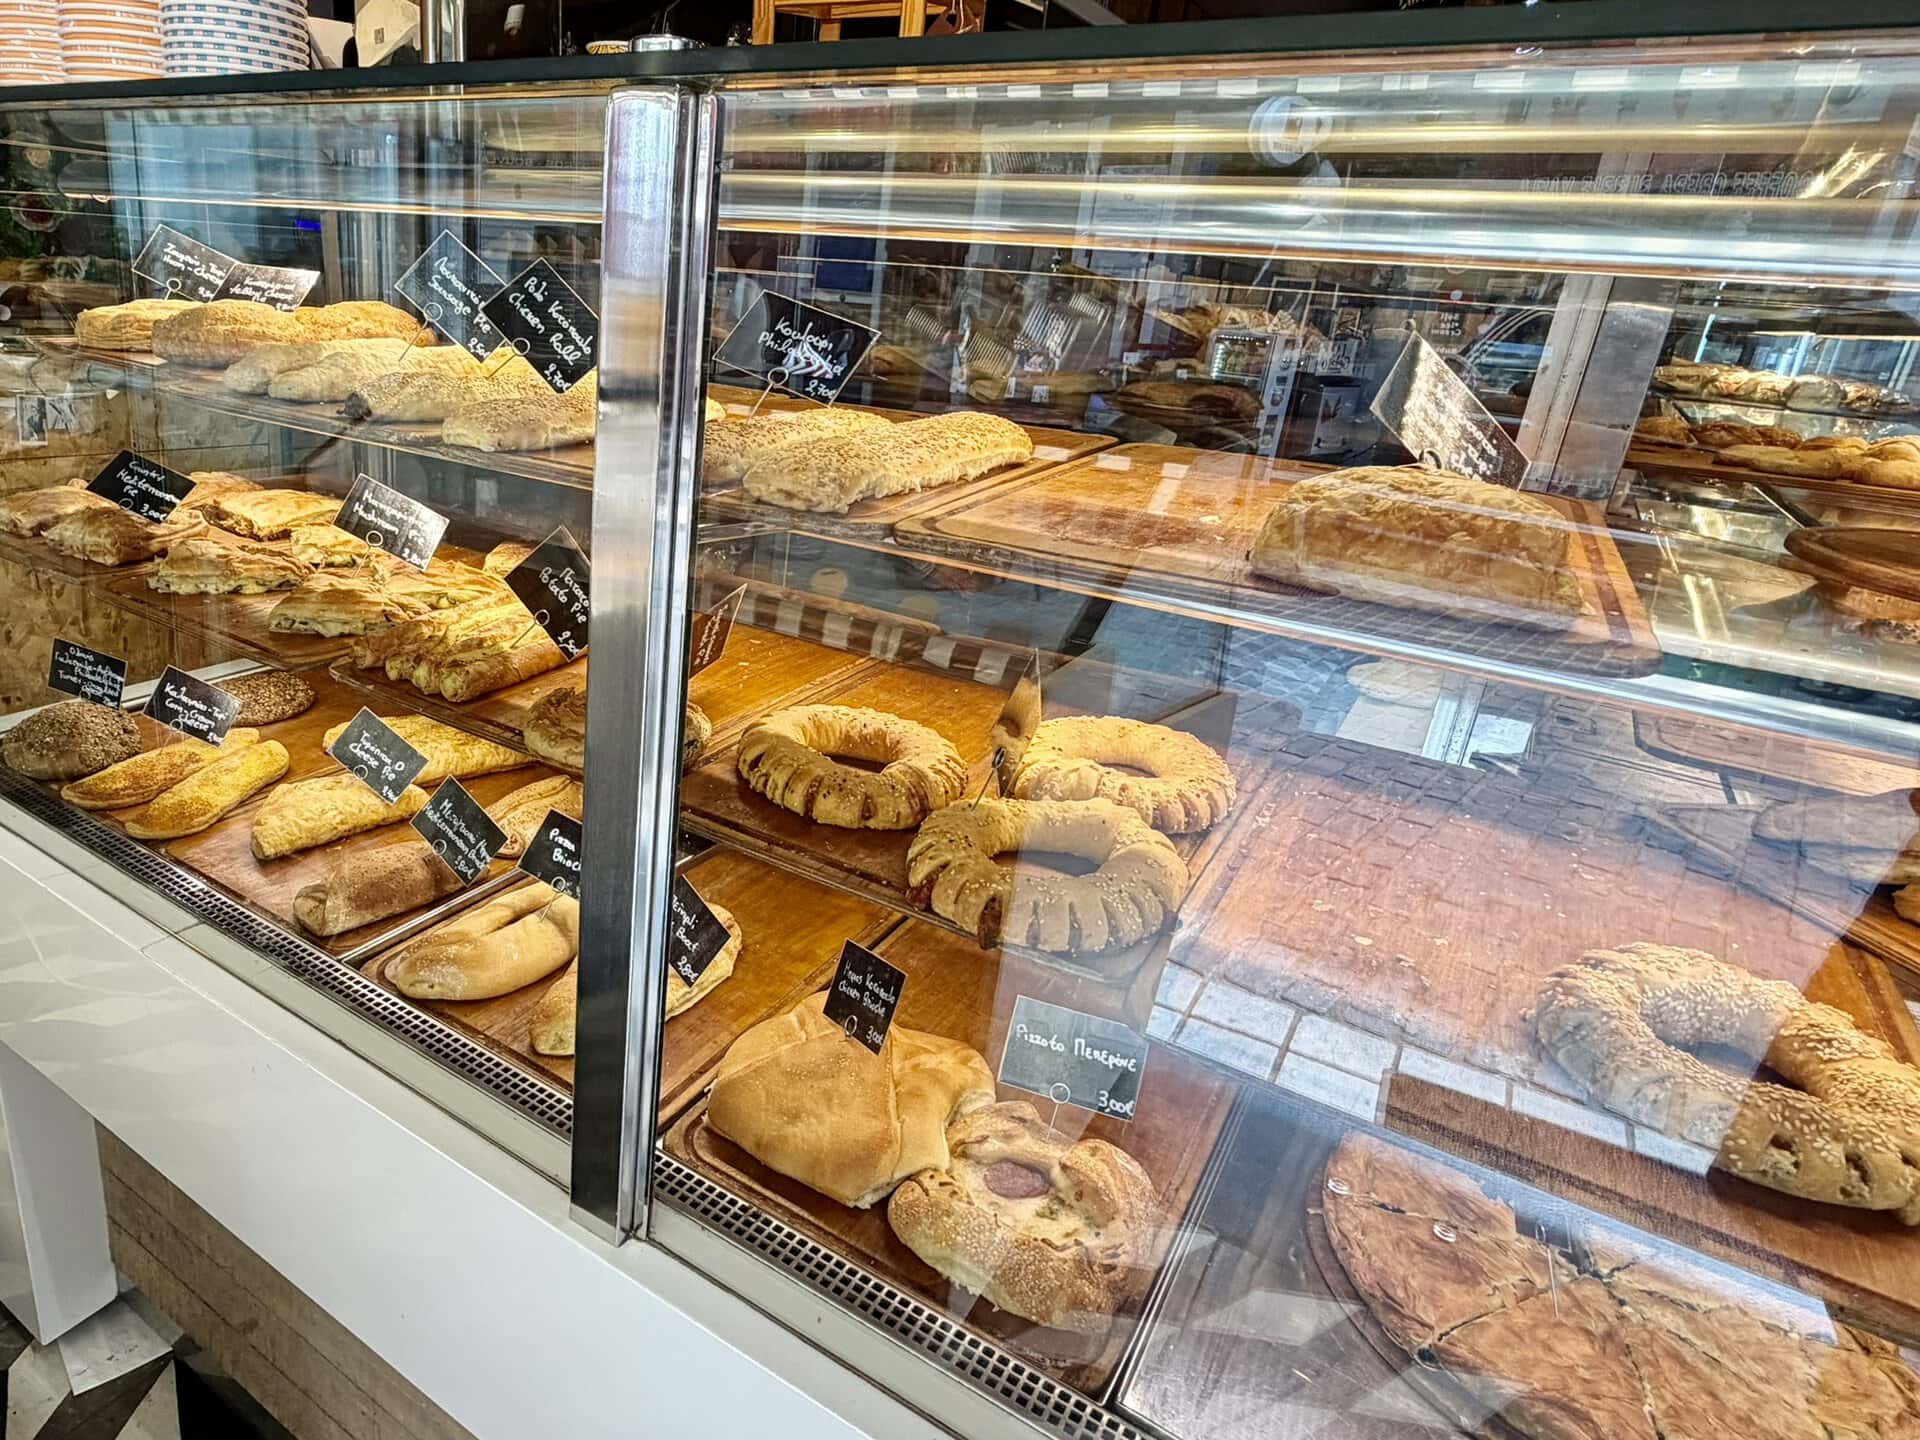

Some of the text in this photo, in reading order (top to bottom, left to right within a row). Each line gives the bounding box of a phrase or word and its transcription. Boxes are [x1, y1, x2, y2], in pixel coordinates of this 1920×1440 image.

[509, 292, 545, 334] Chicken
[539, 567, 588, 624] Potato Pie
